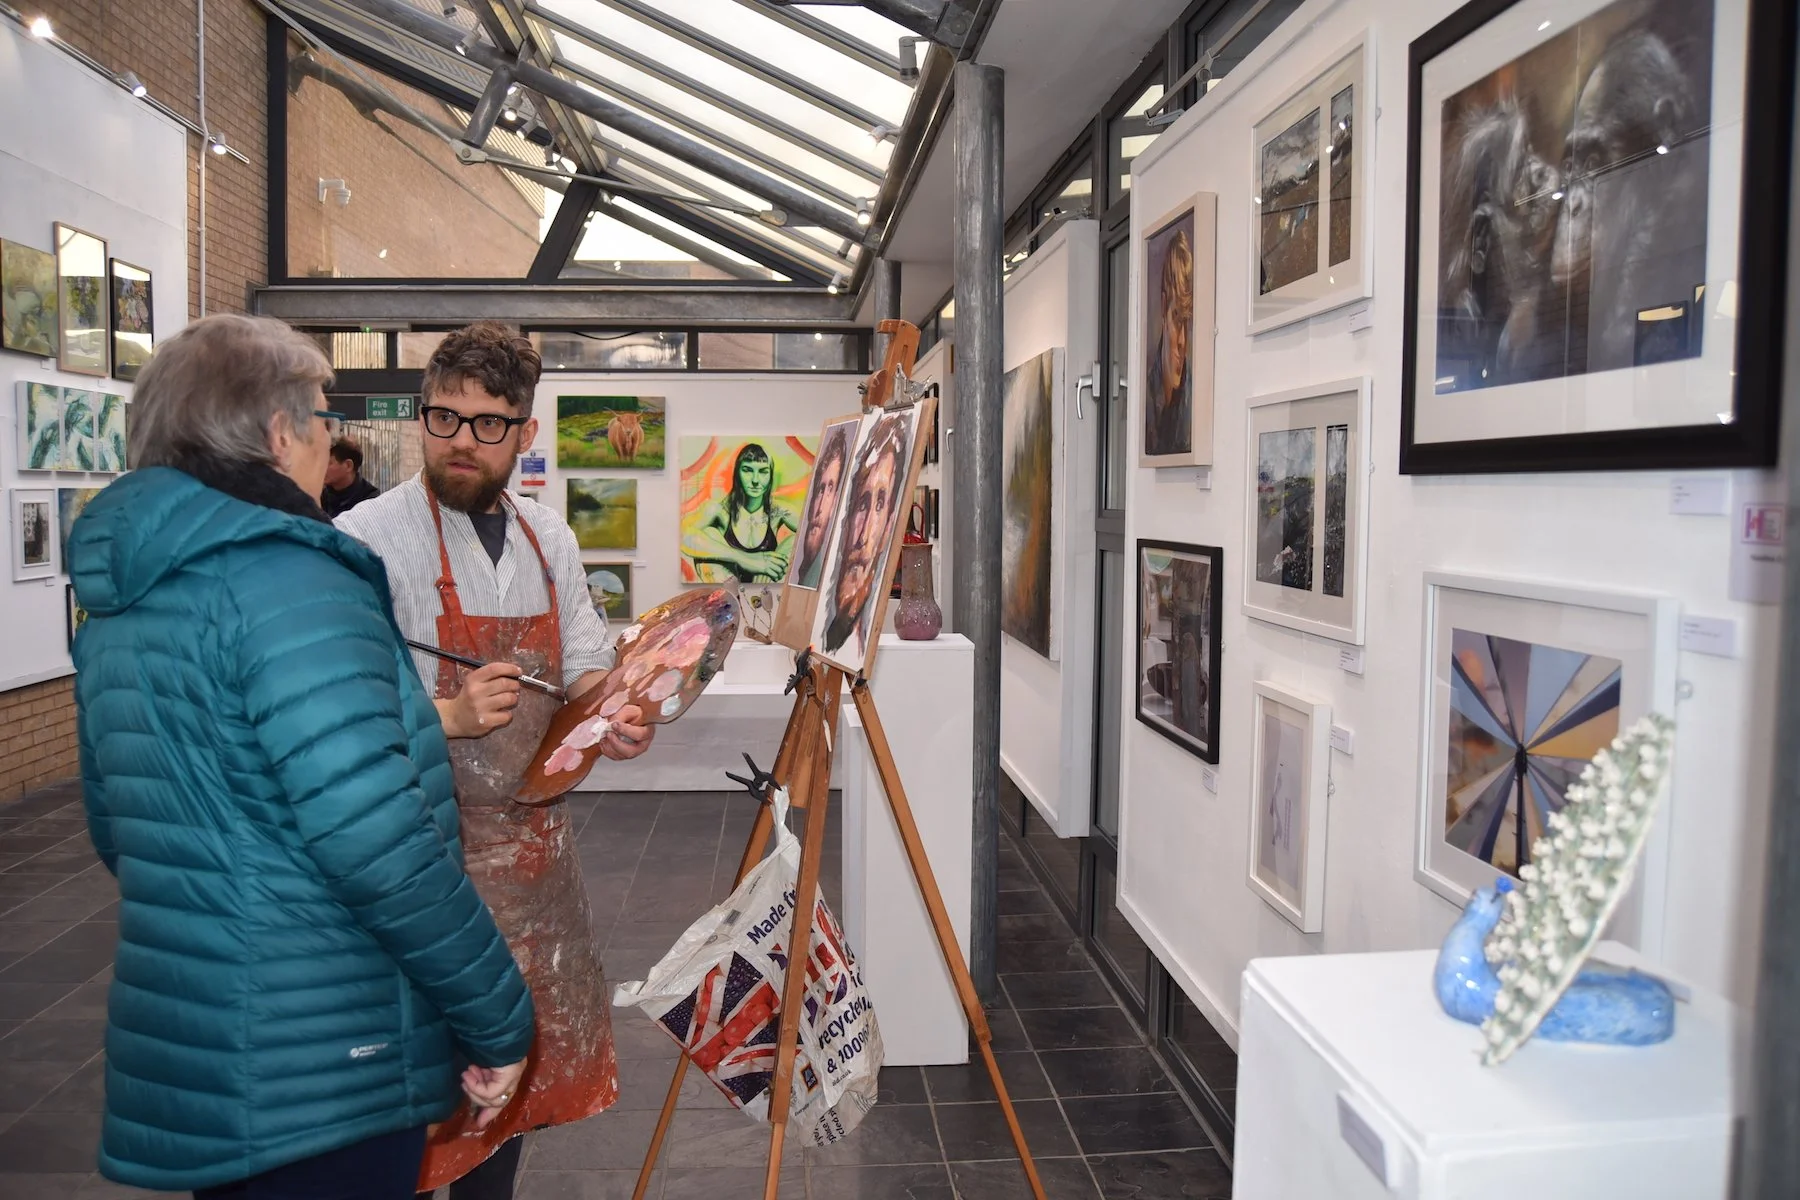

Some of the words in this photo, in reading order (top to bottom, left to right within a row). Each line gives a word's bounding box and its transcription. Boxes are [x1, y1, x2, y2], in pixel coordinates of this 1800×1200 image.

[372, 400, 388, 408] Fire
[372, 409, 387, 417] exit
[746, 904, 787, 945] Made
[783, 889, 798, 909] fr
[827, 1057, 838, 1074] &
